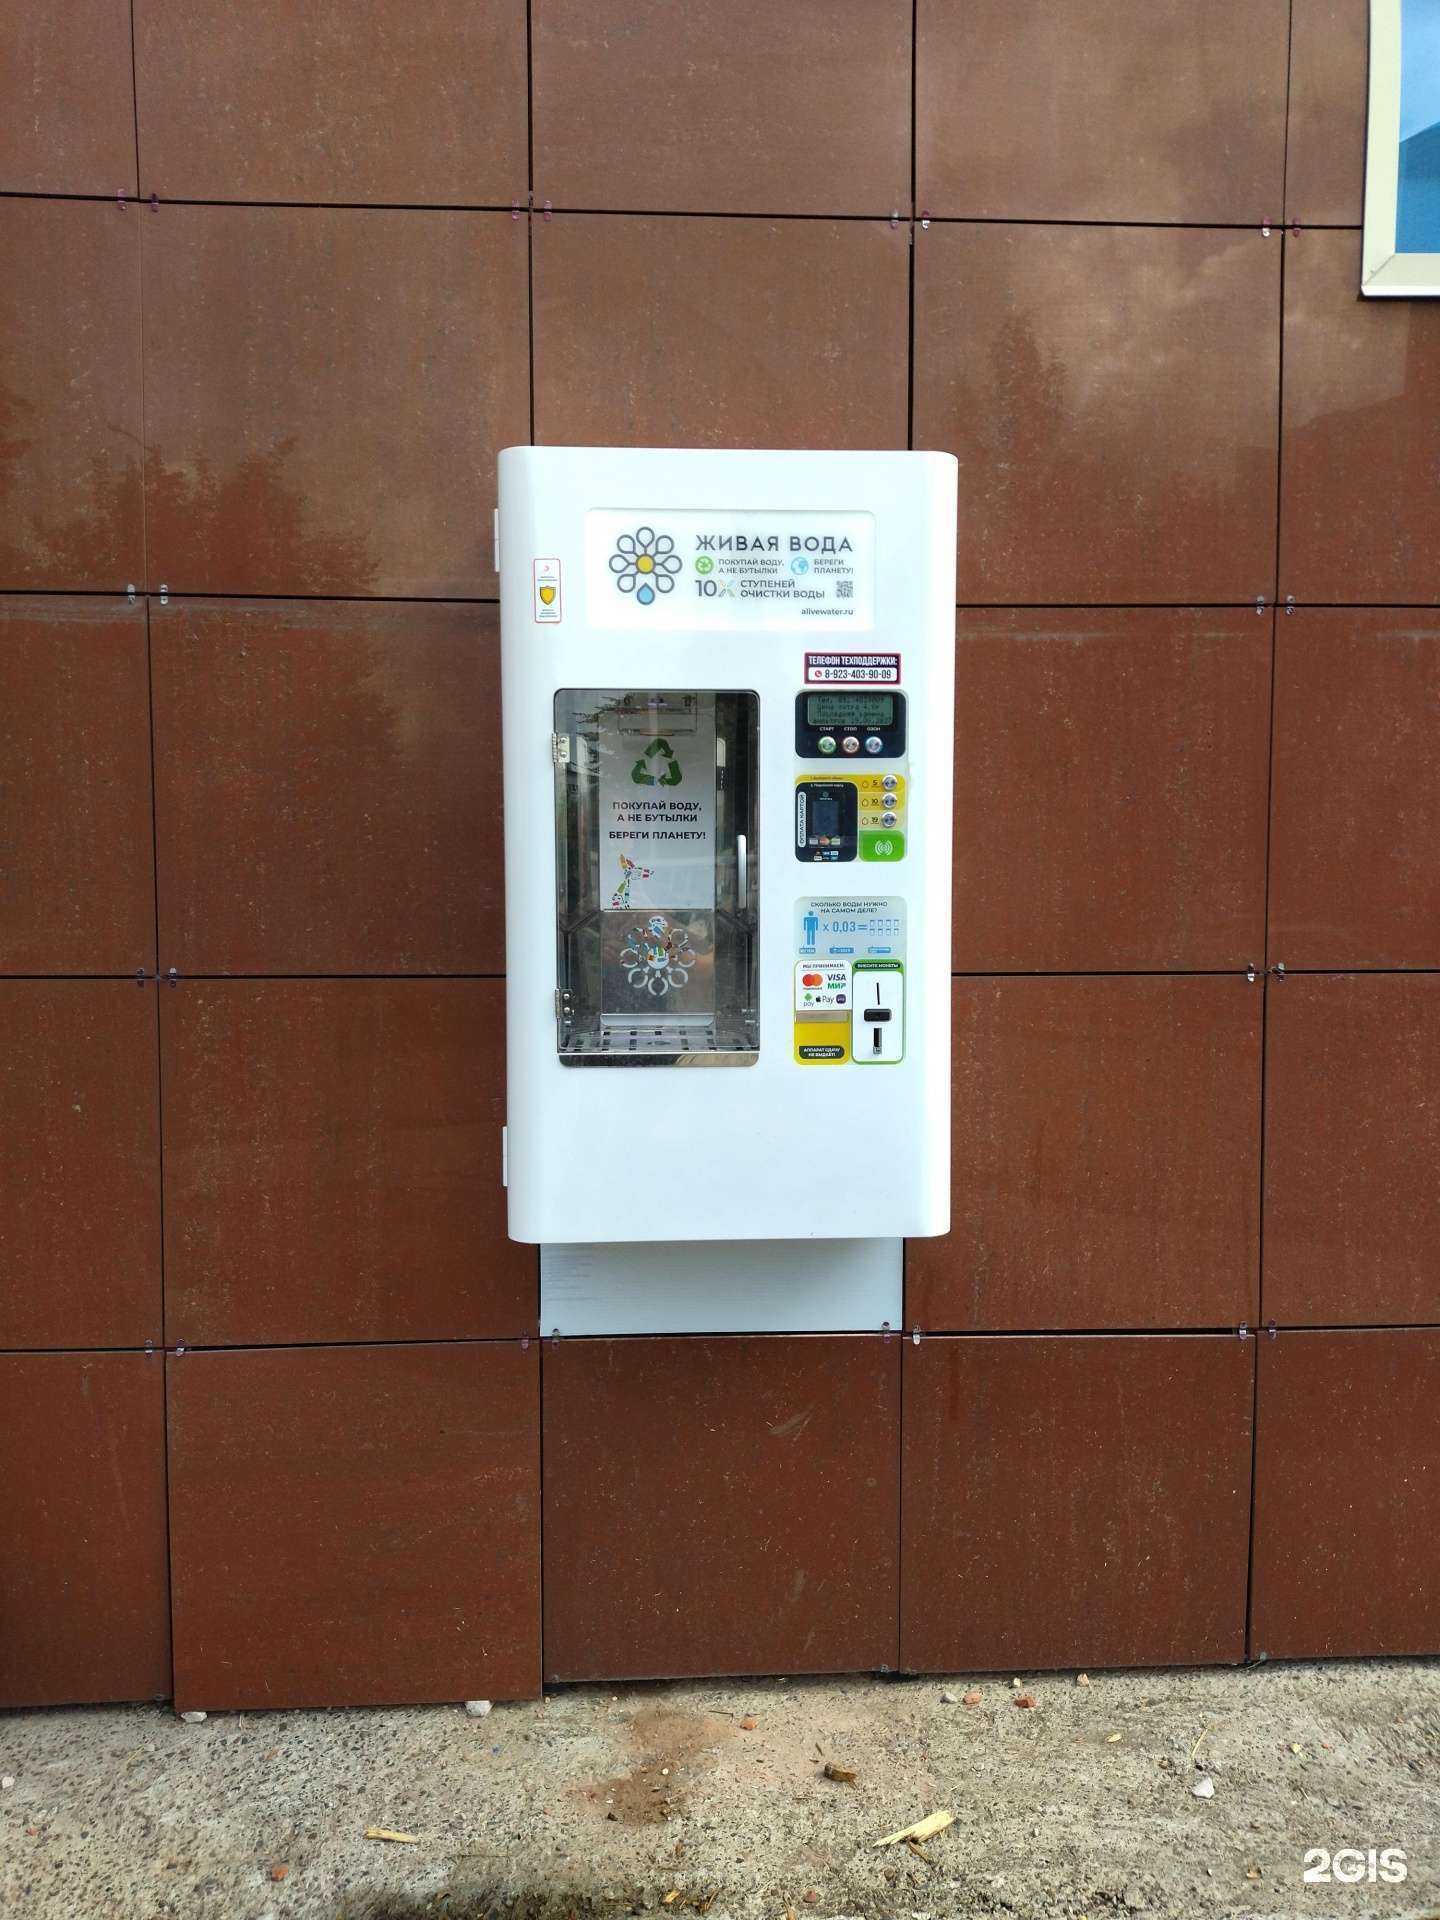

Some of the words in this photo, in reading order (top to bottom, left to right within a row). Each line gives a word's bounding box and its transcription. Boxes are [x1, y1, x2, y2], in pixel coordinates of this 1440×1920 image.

[696, 535, 779, 551] ЖИВАЯ
[790, 536, 853, 554] ВОДА
[718, 558, 759, 566] ПОКУПАЙ
[760, 559, 785, 567] ВОДУ,
[740, 578, 796, 588] СТУПЕНЕЙ
[740, 590, 790, 598] ОЧИСТКИ
[793, 590, 825, 599] ВОДЫ
[801, 607, 854, 616] alivewater.ru
[808, 655, 840, 666] ТЕЛЕФОН
[841, 655, 898, 667] ТЕХПОДДЕРЖКИ:
[612, 801, 666, 811] ПОКУПАЙ
[669, 802, 702, 812] ВОДУ,
[609, 831, 649, 839] БЕРЕГИ
[652, 831, 706, 839] ПЛАНЕТУ!
